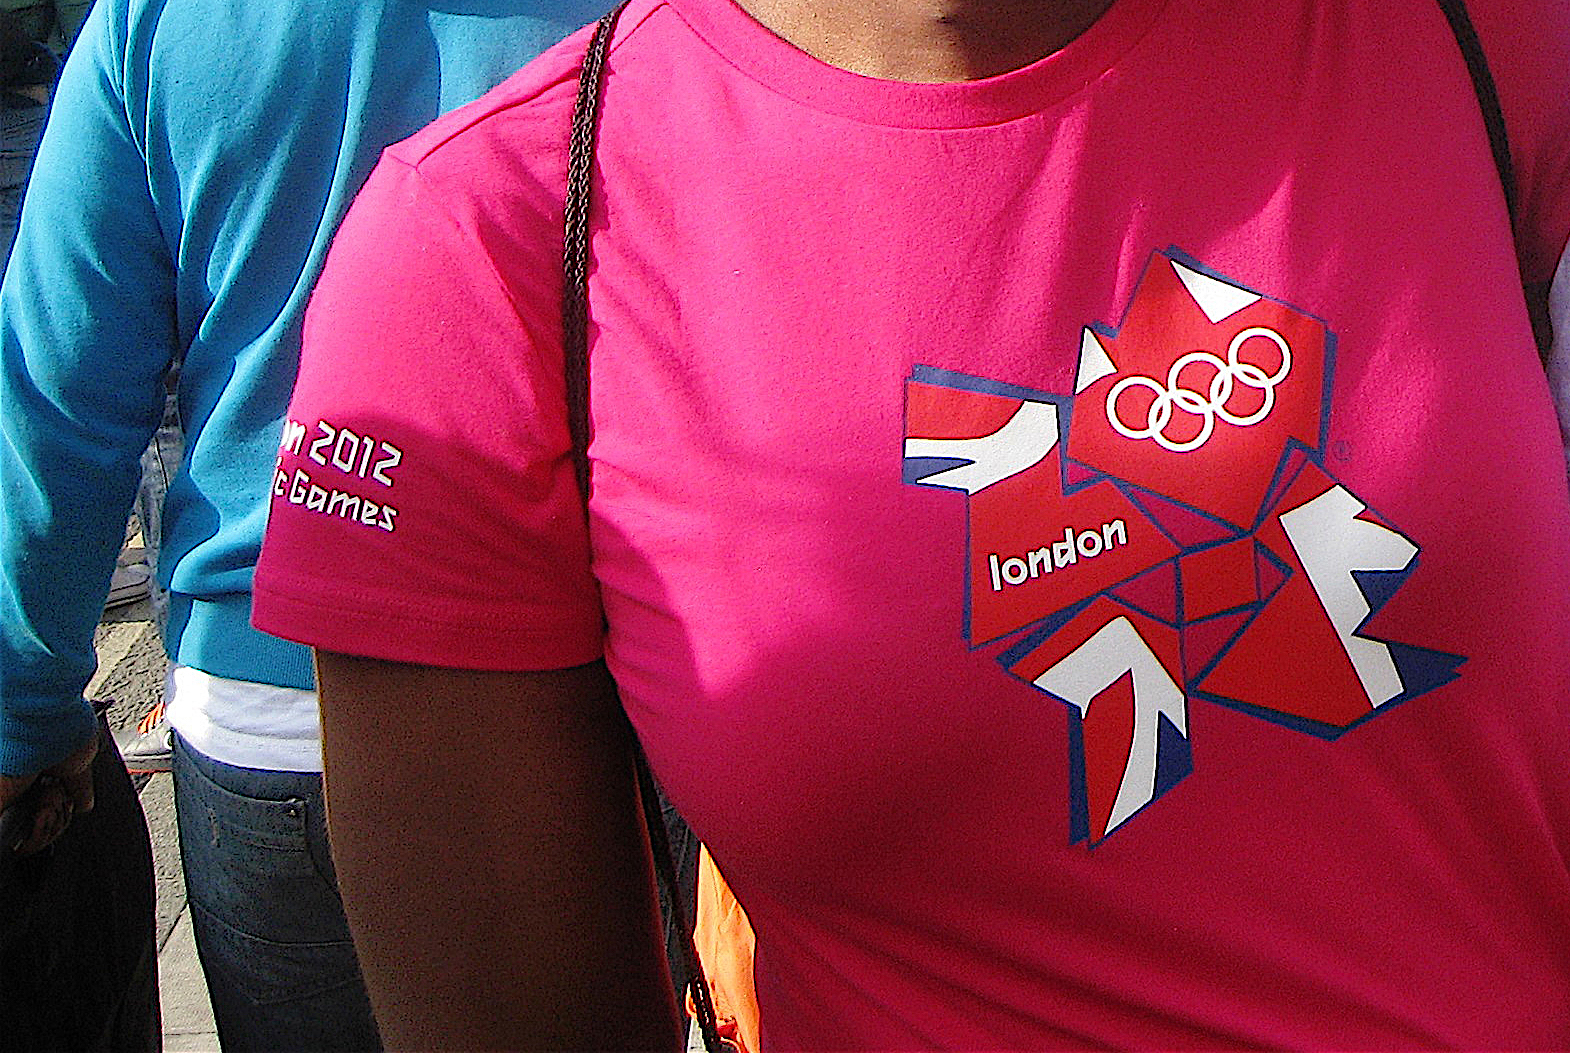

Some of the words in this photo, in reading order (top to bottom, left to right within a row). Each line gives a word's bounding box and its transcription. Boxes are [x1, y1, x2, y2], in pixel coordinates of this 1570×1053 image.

[309, 420, 403, 487] 2012
[289, 468, 399, 532] Games
[989, 519, 1128, 592] london
